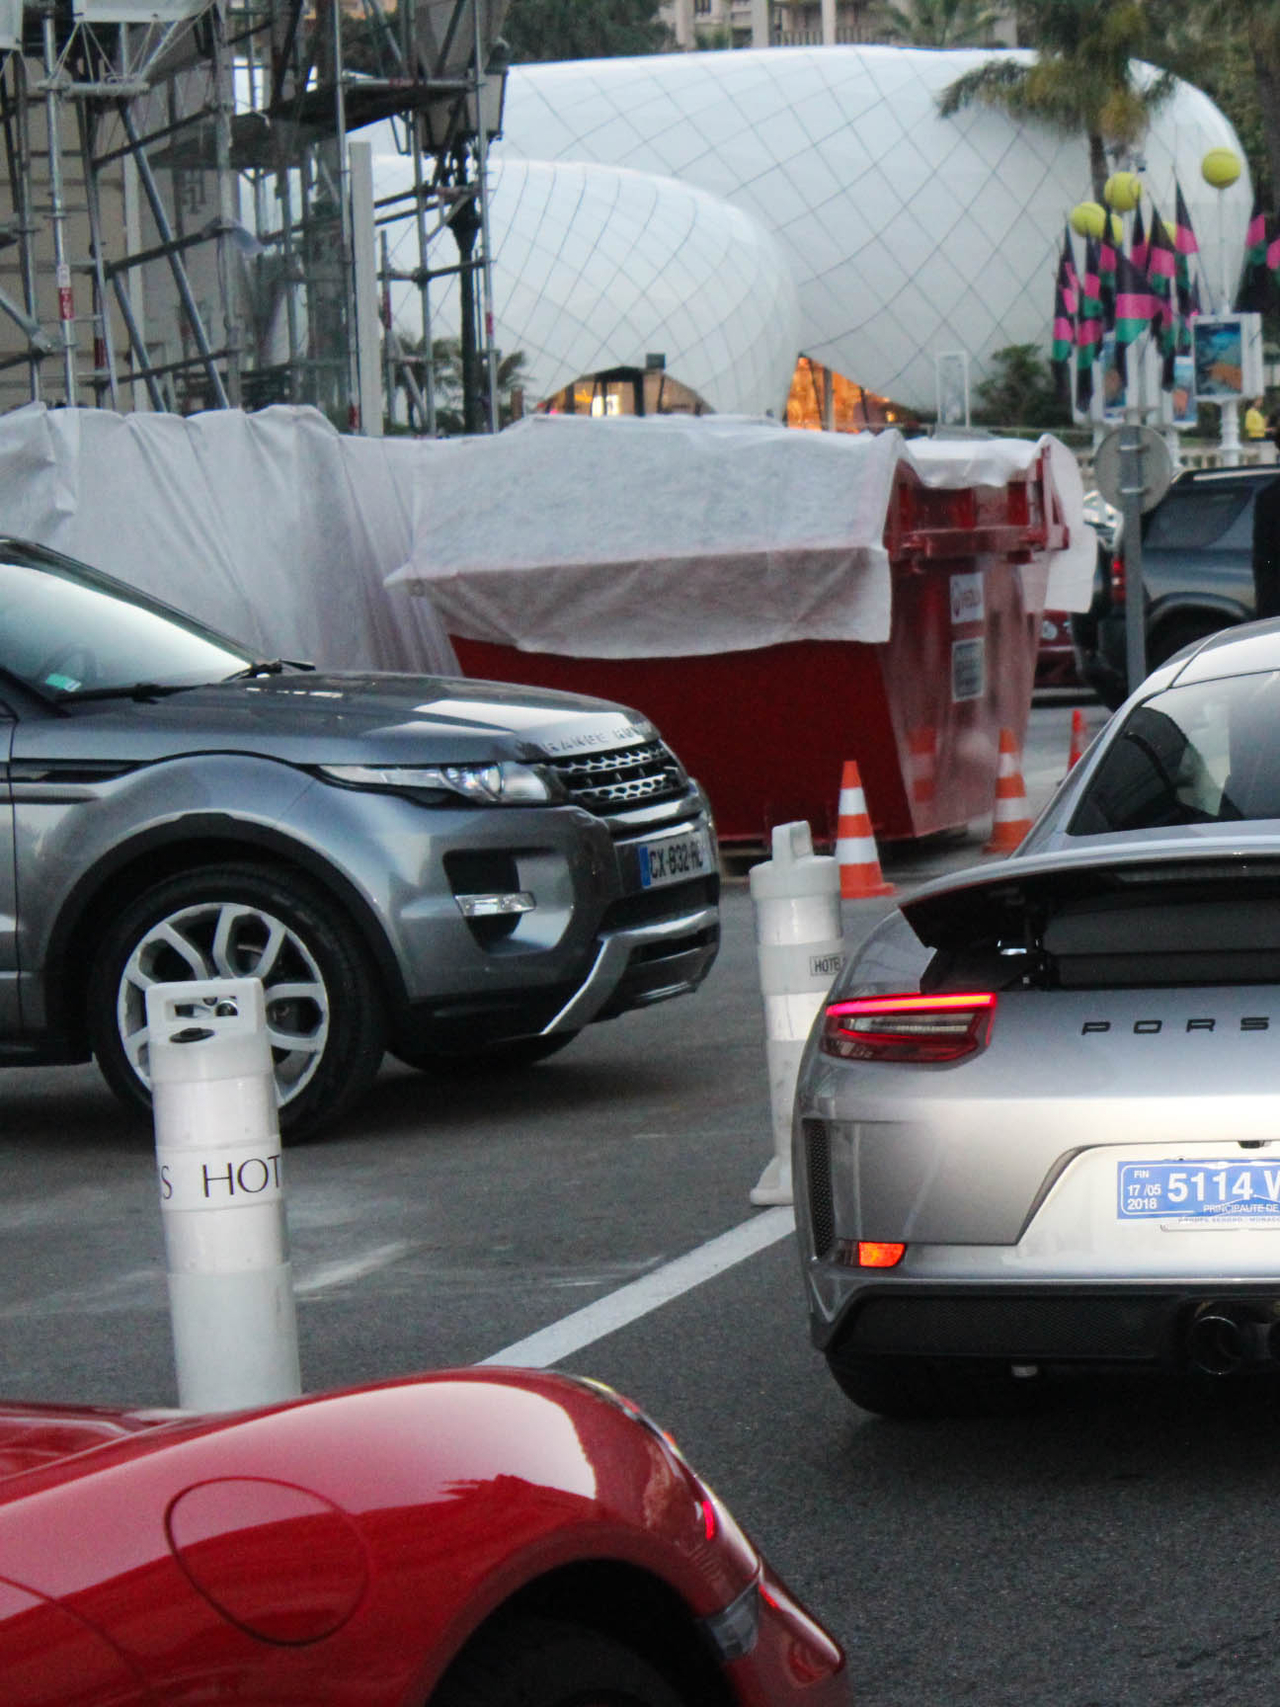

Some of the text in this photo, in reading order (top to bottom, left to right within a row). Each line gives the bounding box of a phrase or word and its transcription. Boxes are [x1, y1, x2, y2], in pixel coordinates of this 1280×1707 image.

[1133, 1170, 1150, 1179] FIN
[1127, 1184, 1141, 1196] 17
[1167, 1171, 1254, 1202] 5114
[1127, 1197, 1158, 1211] 2018
